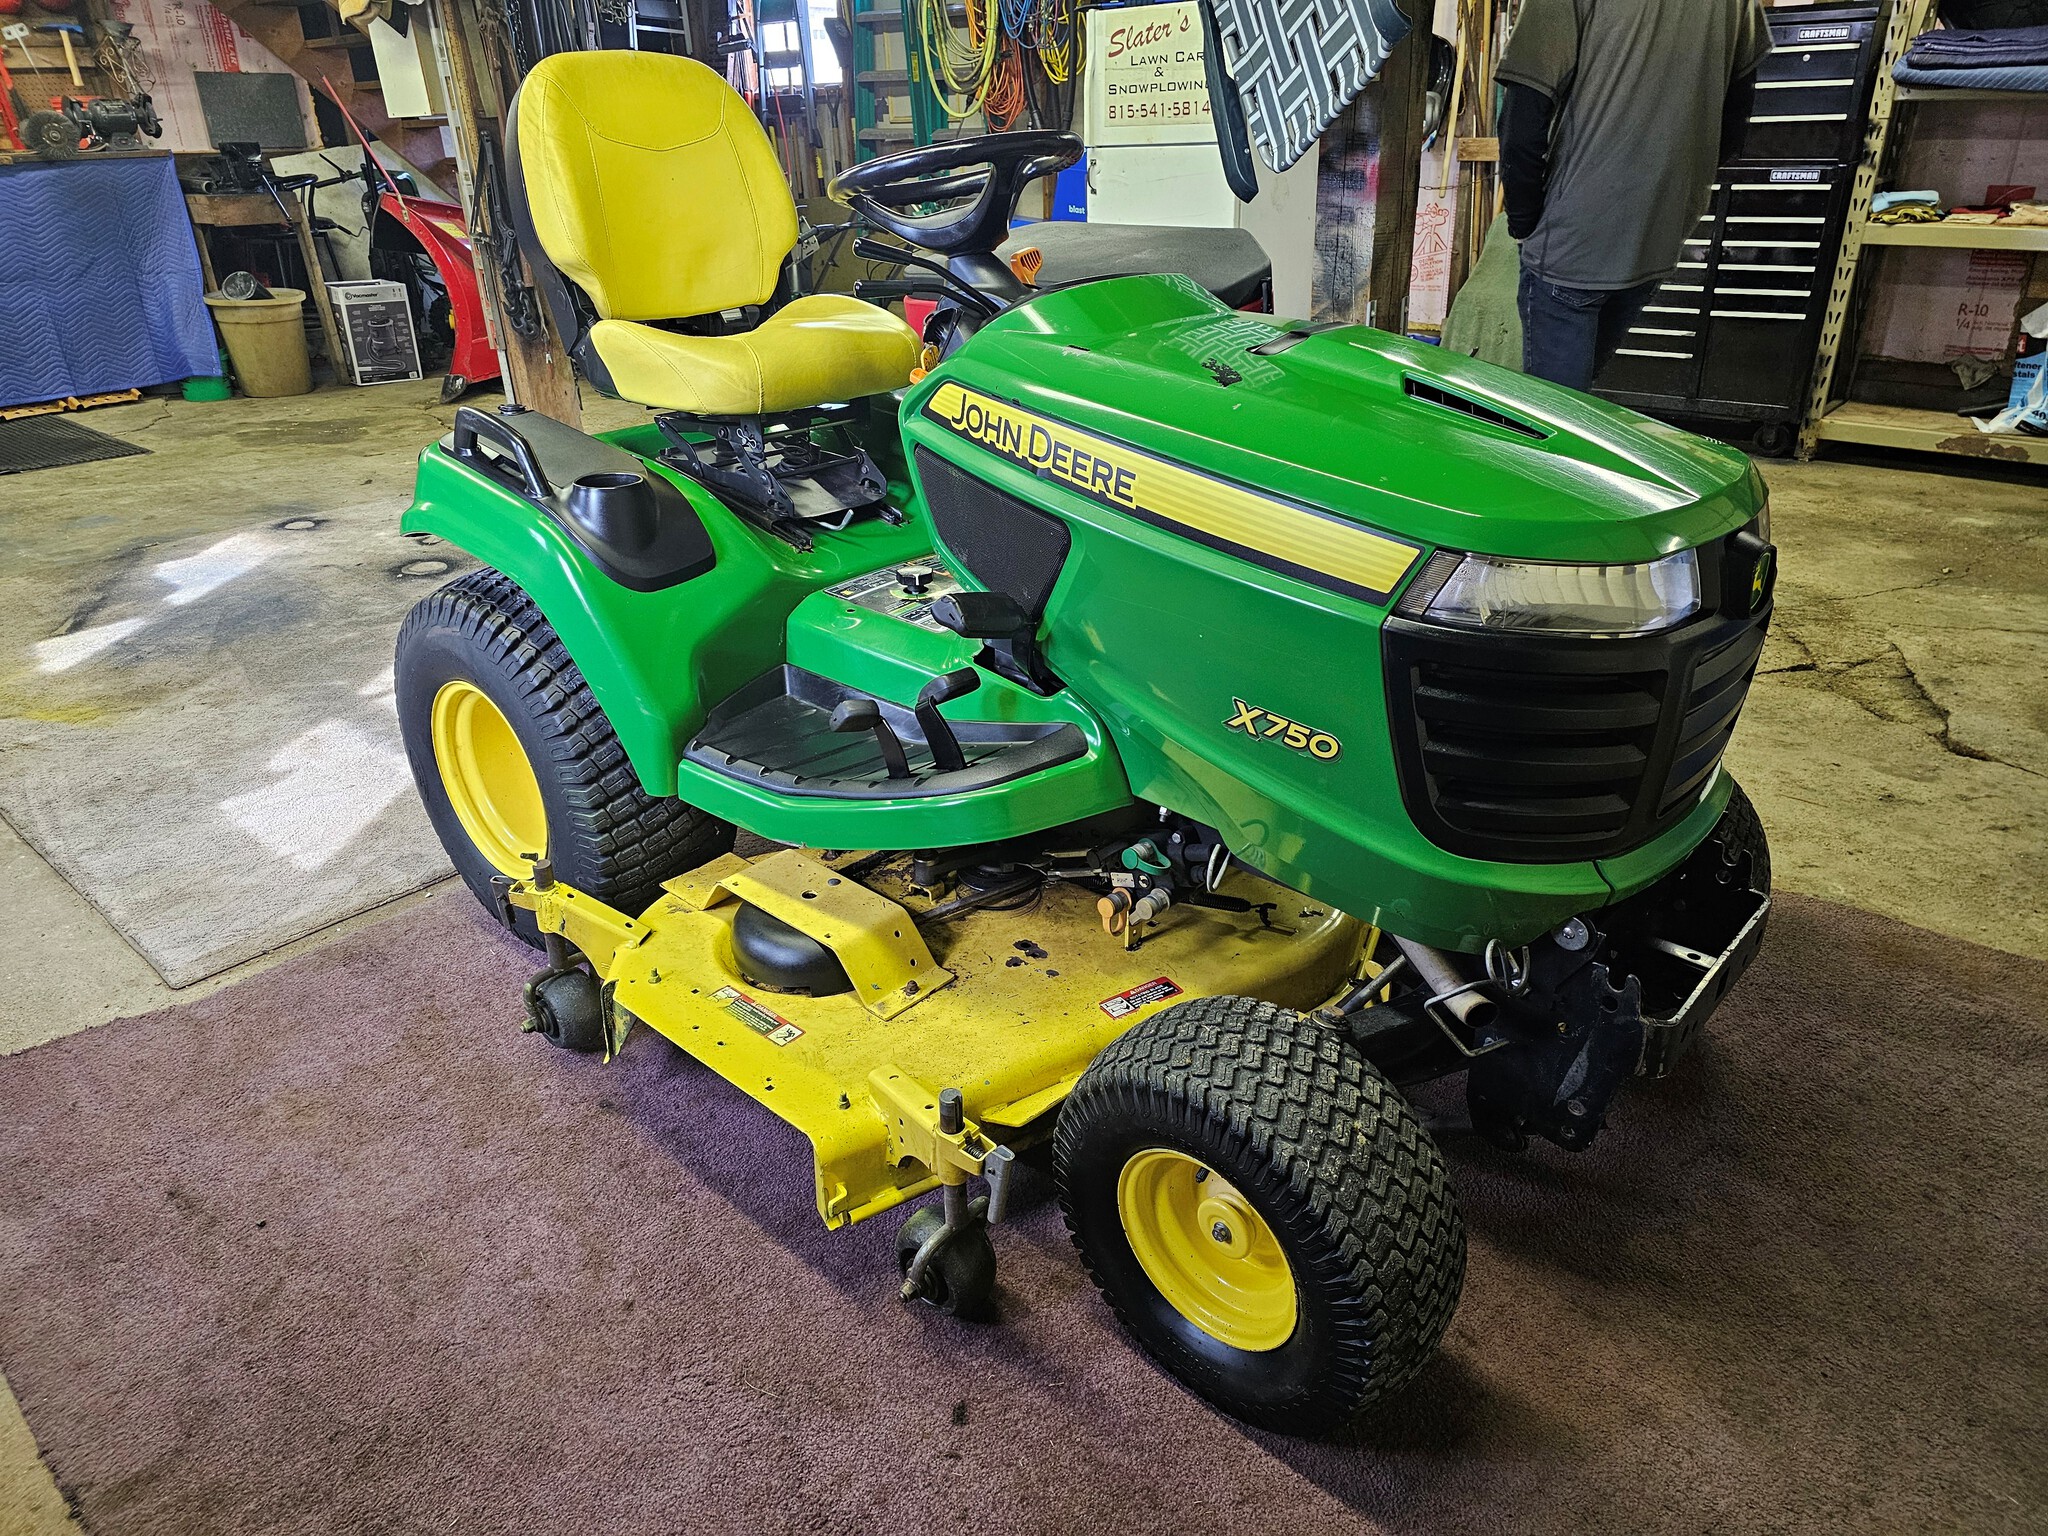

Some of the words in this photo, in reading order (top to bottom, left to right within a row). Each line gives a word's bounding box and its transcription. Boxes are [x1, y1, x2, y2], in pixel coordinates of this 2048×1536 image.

[1108, 9, 1191, 58] Slater's
[1799, 27, 1848, 39] CRAFTSMAN
[1130, 54, 1168, 66] LAWN
[1175, 51, 1205, 63] CAR
[1154, 66, 1164, 77] &
[1771, 171, 1819, 181] CRAFTSMAN
[1068, 204, 1086, 215] blast
[2014, 361, 2043, 370] ftener
[2013, 371, 2036, 379] stals
[951, 393, 1022, 453] JOHN
[1028, 423, 1137, 504] DEERE
[1225, 698, 1341, 760] X750
